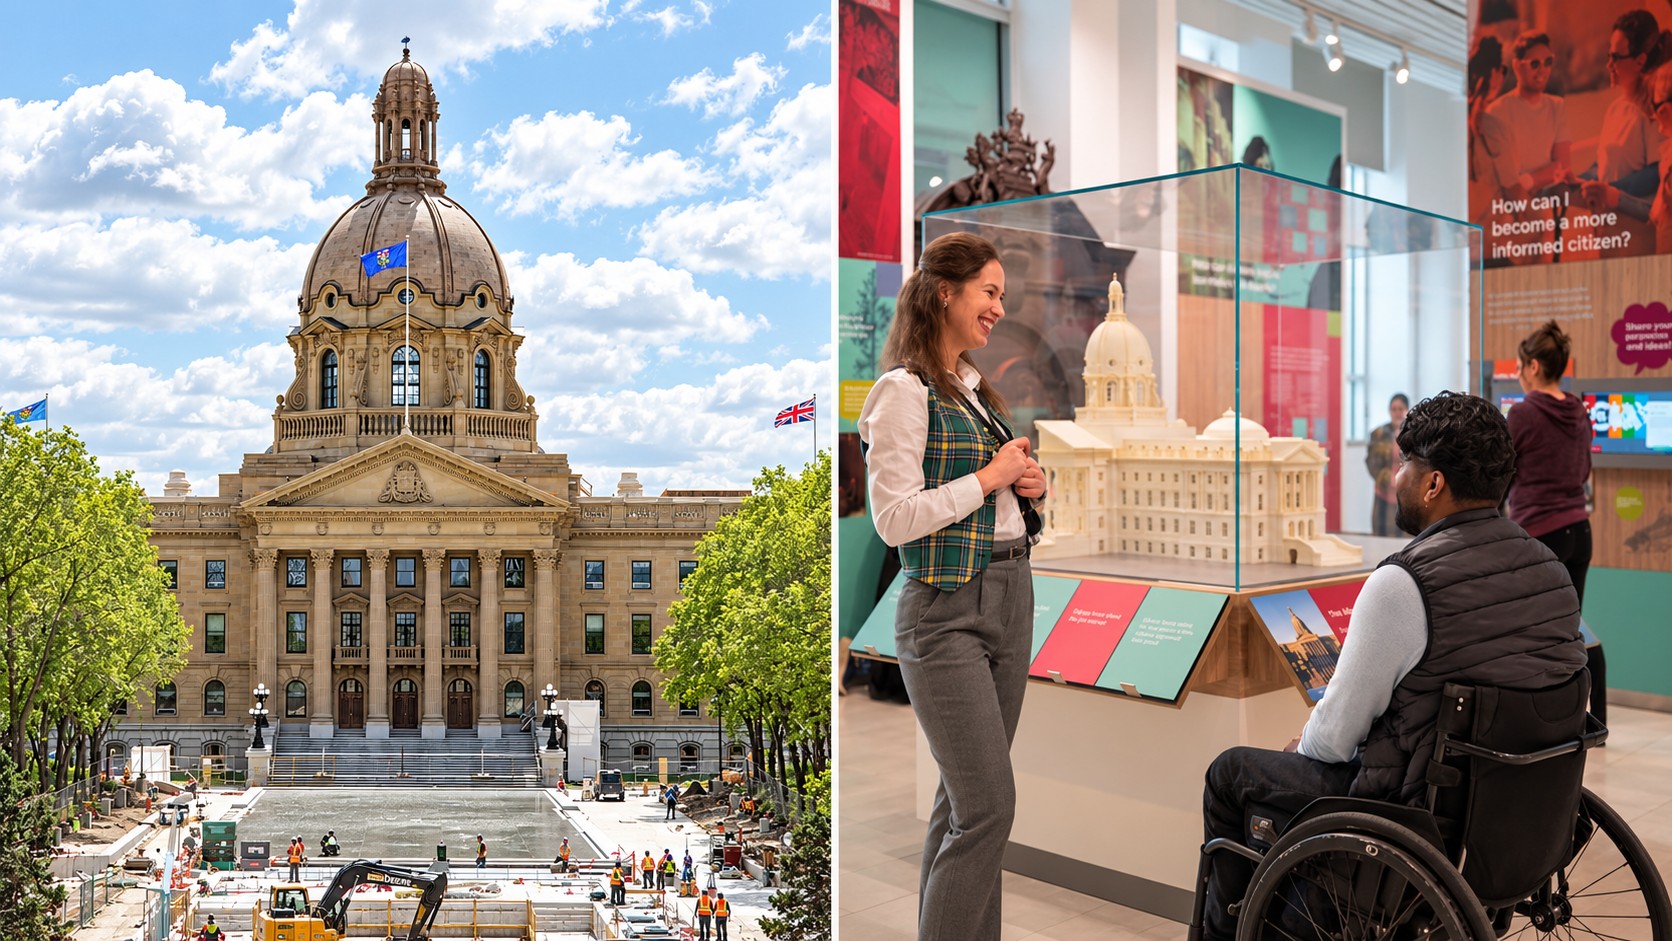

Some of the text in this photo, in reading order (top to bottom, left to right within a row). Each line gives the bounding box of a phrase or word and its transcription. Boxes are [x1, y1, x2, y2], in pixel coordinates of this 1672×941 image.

[1492, 192, 1569, 215] How can I
[1492, 212, 1617, 237] become a more
[1492, 231, 1631, 259] informed citizen?
